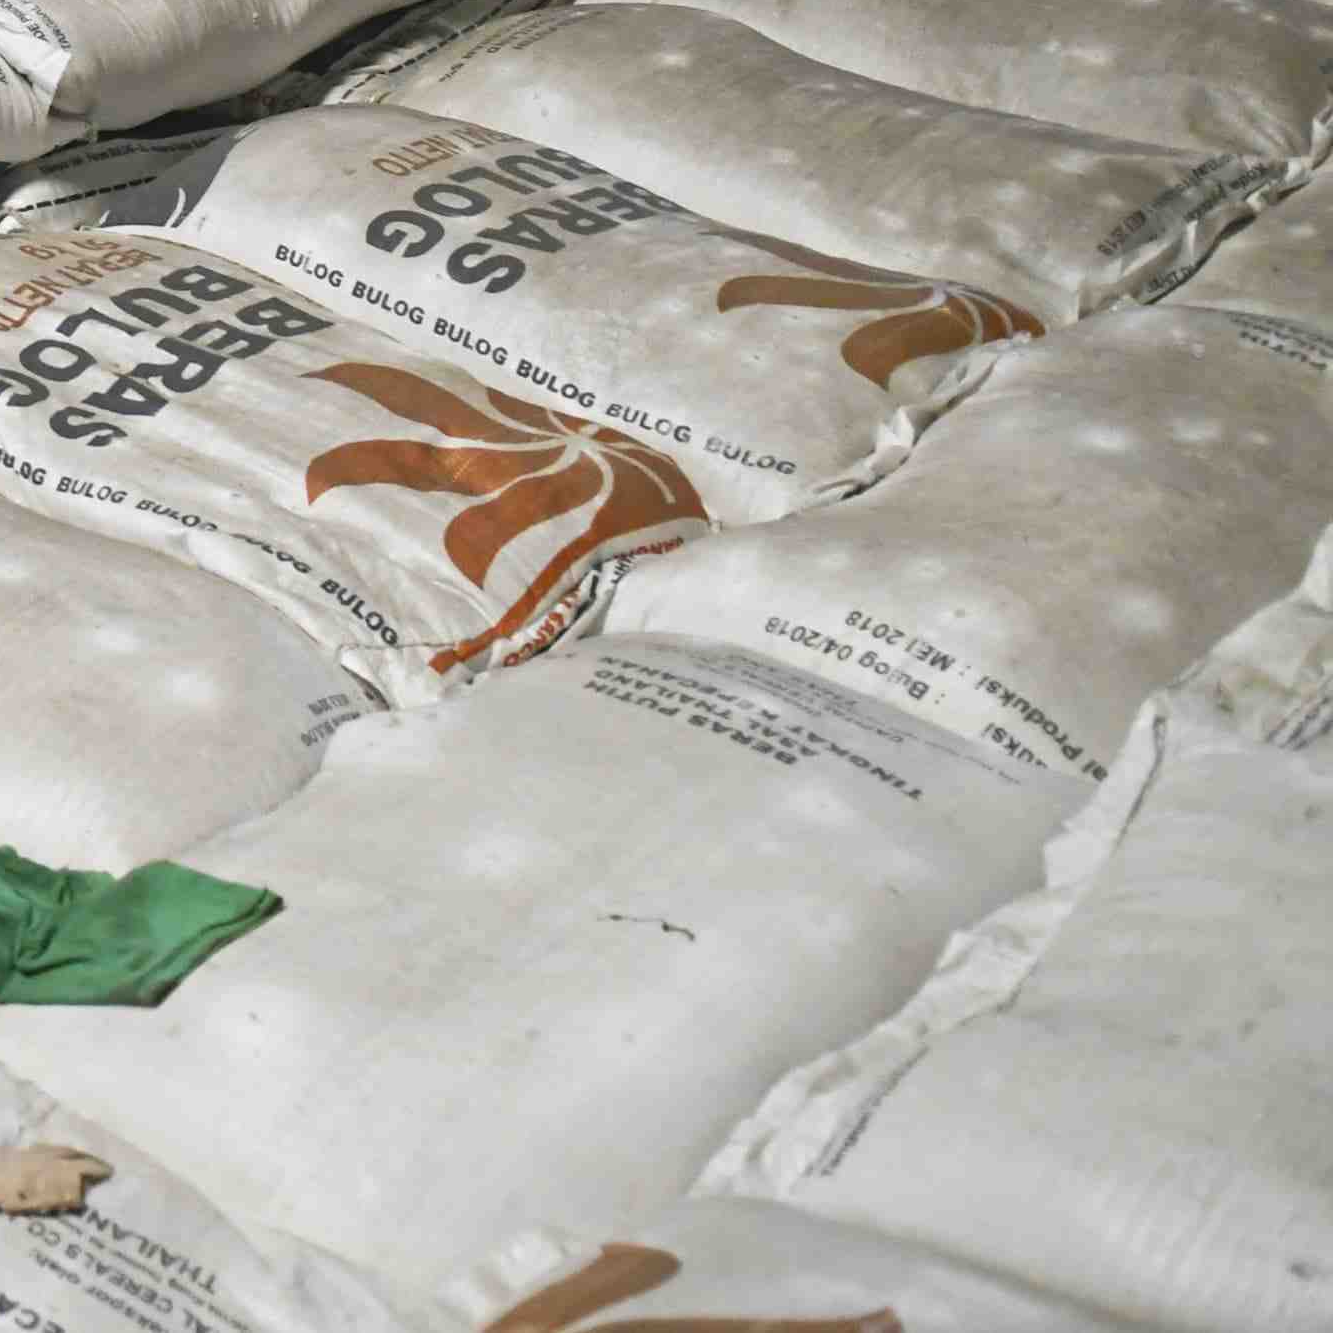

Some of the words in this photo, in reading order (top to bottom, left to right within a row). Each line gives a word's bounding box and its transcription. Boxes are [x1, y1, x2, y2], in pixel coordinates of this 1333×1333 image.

[364, 146, 615, 259] BULOG
[445, 180, 699, 295] BERAS
[49, 296, 334, 447] BERAS
[274, 243, 345, 289] BULOG
[351, 279, 427, 326] BULOG
[432, 315, 509, 367] BULOG
[515, 356, 598, 411] BULOG
[605, 401, 693, 446] BULOG
[703, 435, 798, 478] BULOG
[56, 474, 129, 505] BULOG
[319, 577, 403, 648] BULOG
[764, 616, 855, 664] 04/2018
[844, 610, 900, 647] 2018
[902, 631, 956, 675] MEI
[581, 679, 680, 719] PUTIH
[593, 667, 736, 723] THAILAND
[973, 675, 1085, 762] Produksi
[689, 712, 801, 767] BERAS
[785, 723, 924, 803] TINGKAT
[66, 1242, 174, 1315] CEREALS
[85, 1204, 219, 1296] THAILAN
